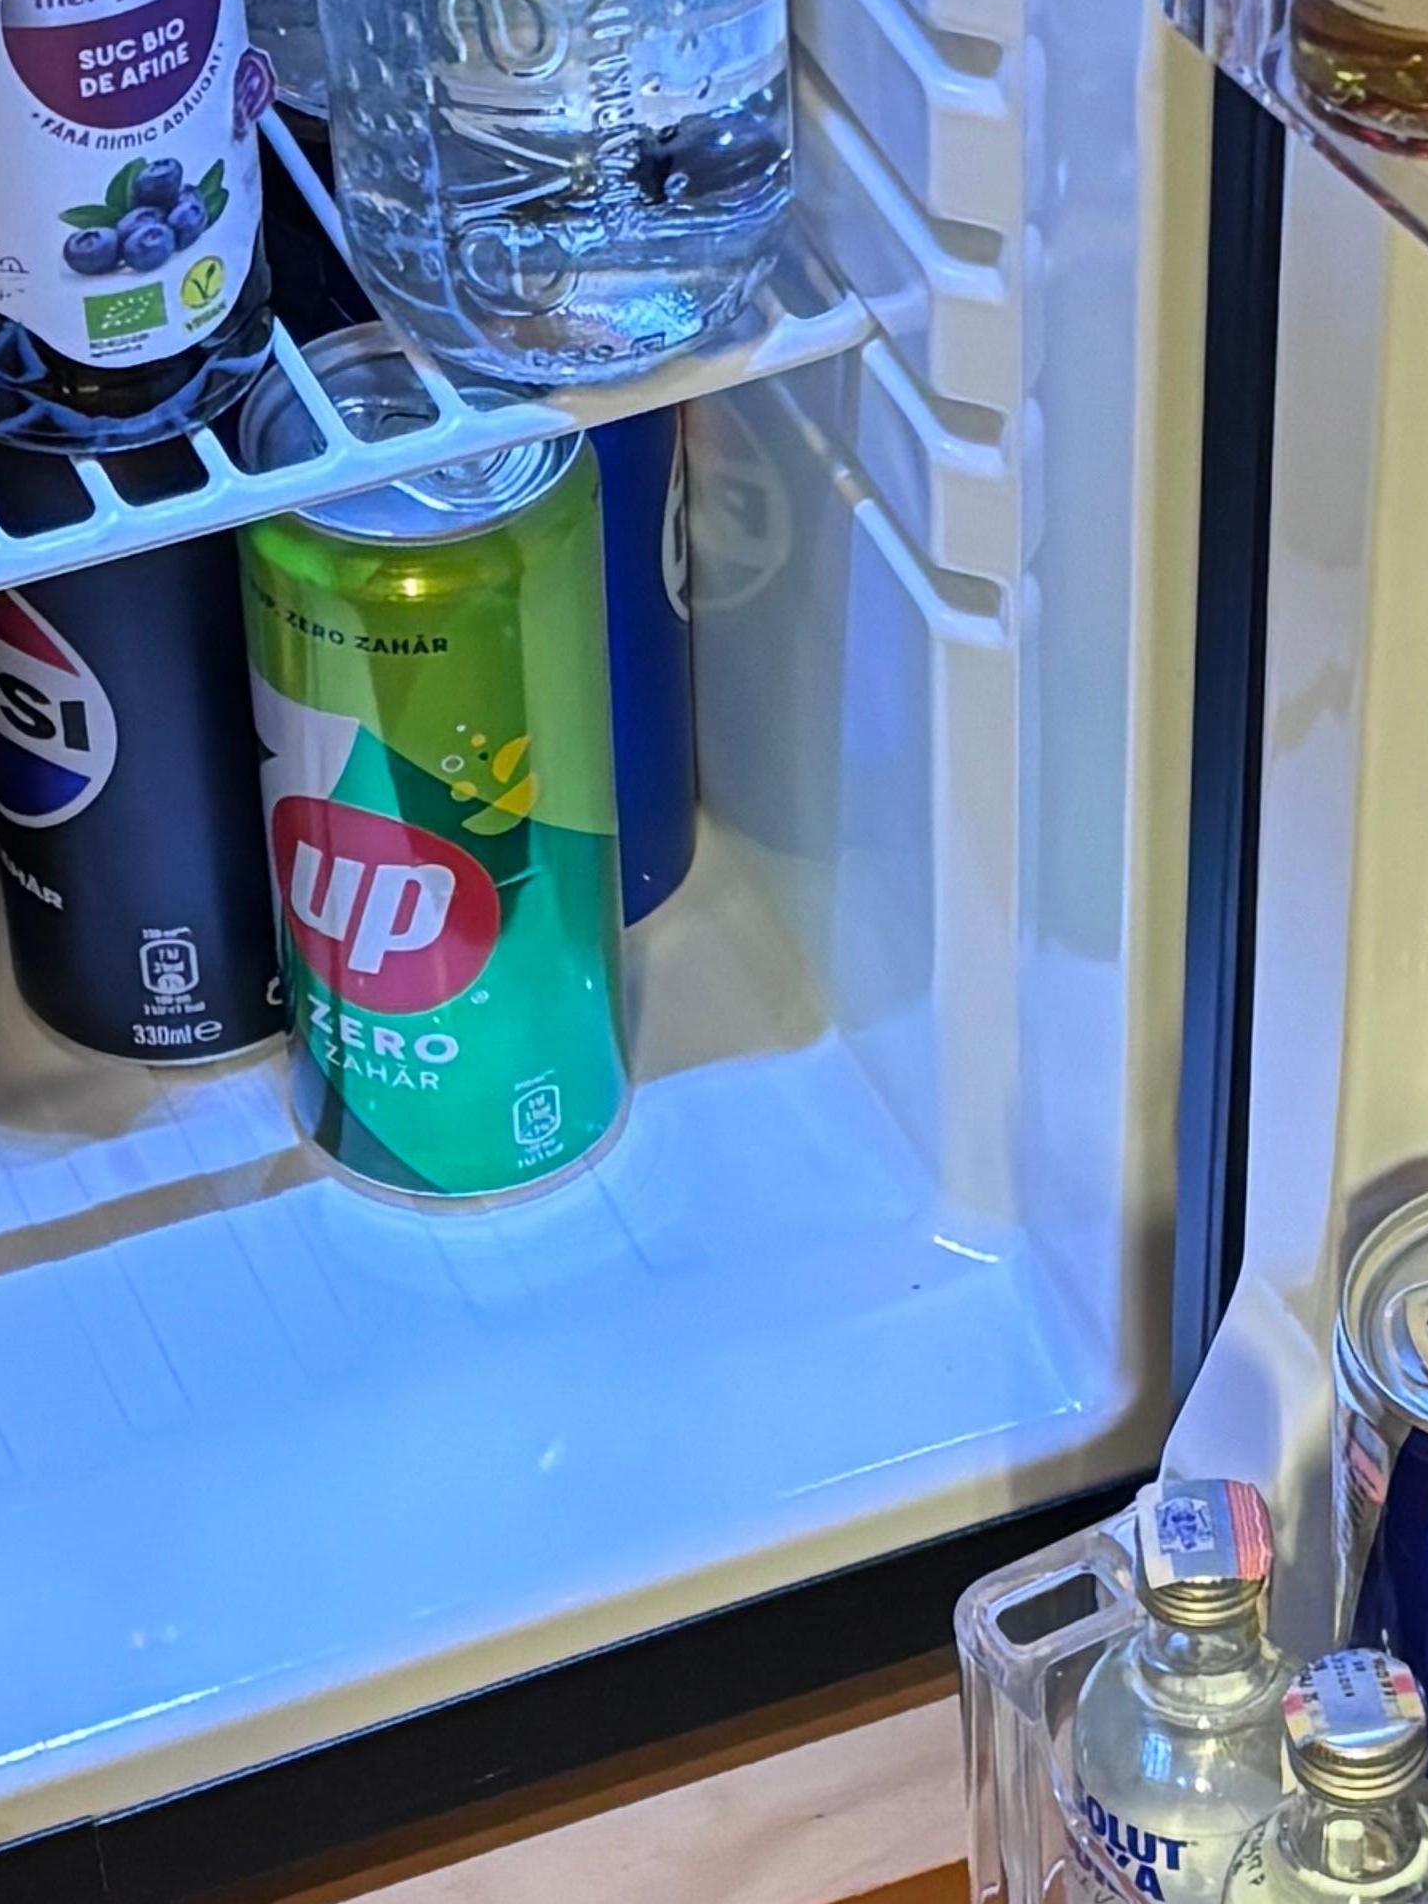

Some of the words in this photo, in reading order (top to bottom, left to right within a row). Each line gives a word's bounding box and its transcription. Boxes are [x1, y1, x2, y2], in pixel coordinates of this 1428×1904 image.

[78, 38, 137, 71] SUC
[142, 17, 185, 53] BIO
[79, 72, 116, 99] DE
[120, 41, 190, 90] AFINE
[308, 993, 460, 1064] ZERO
[325, 1039, 440, 1091] ZAHĂR
